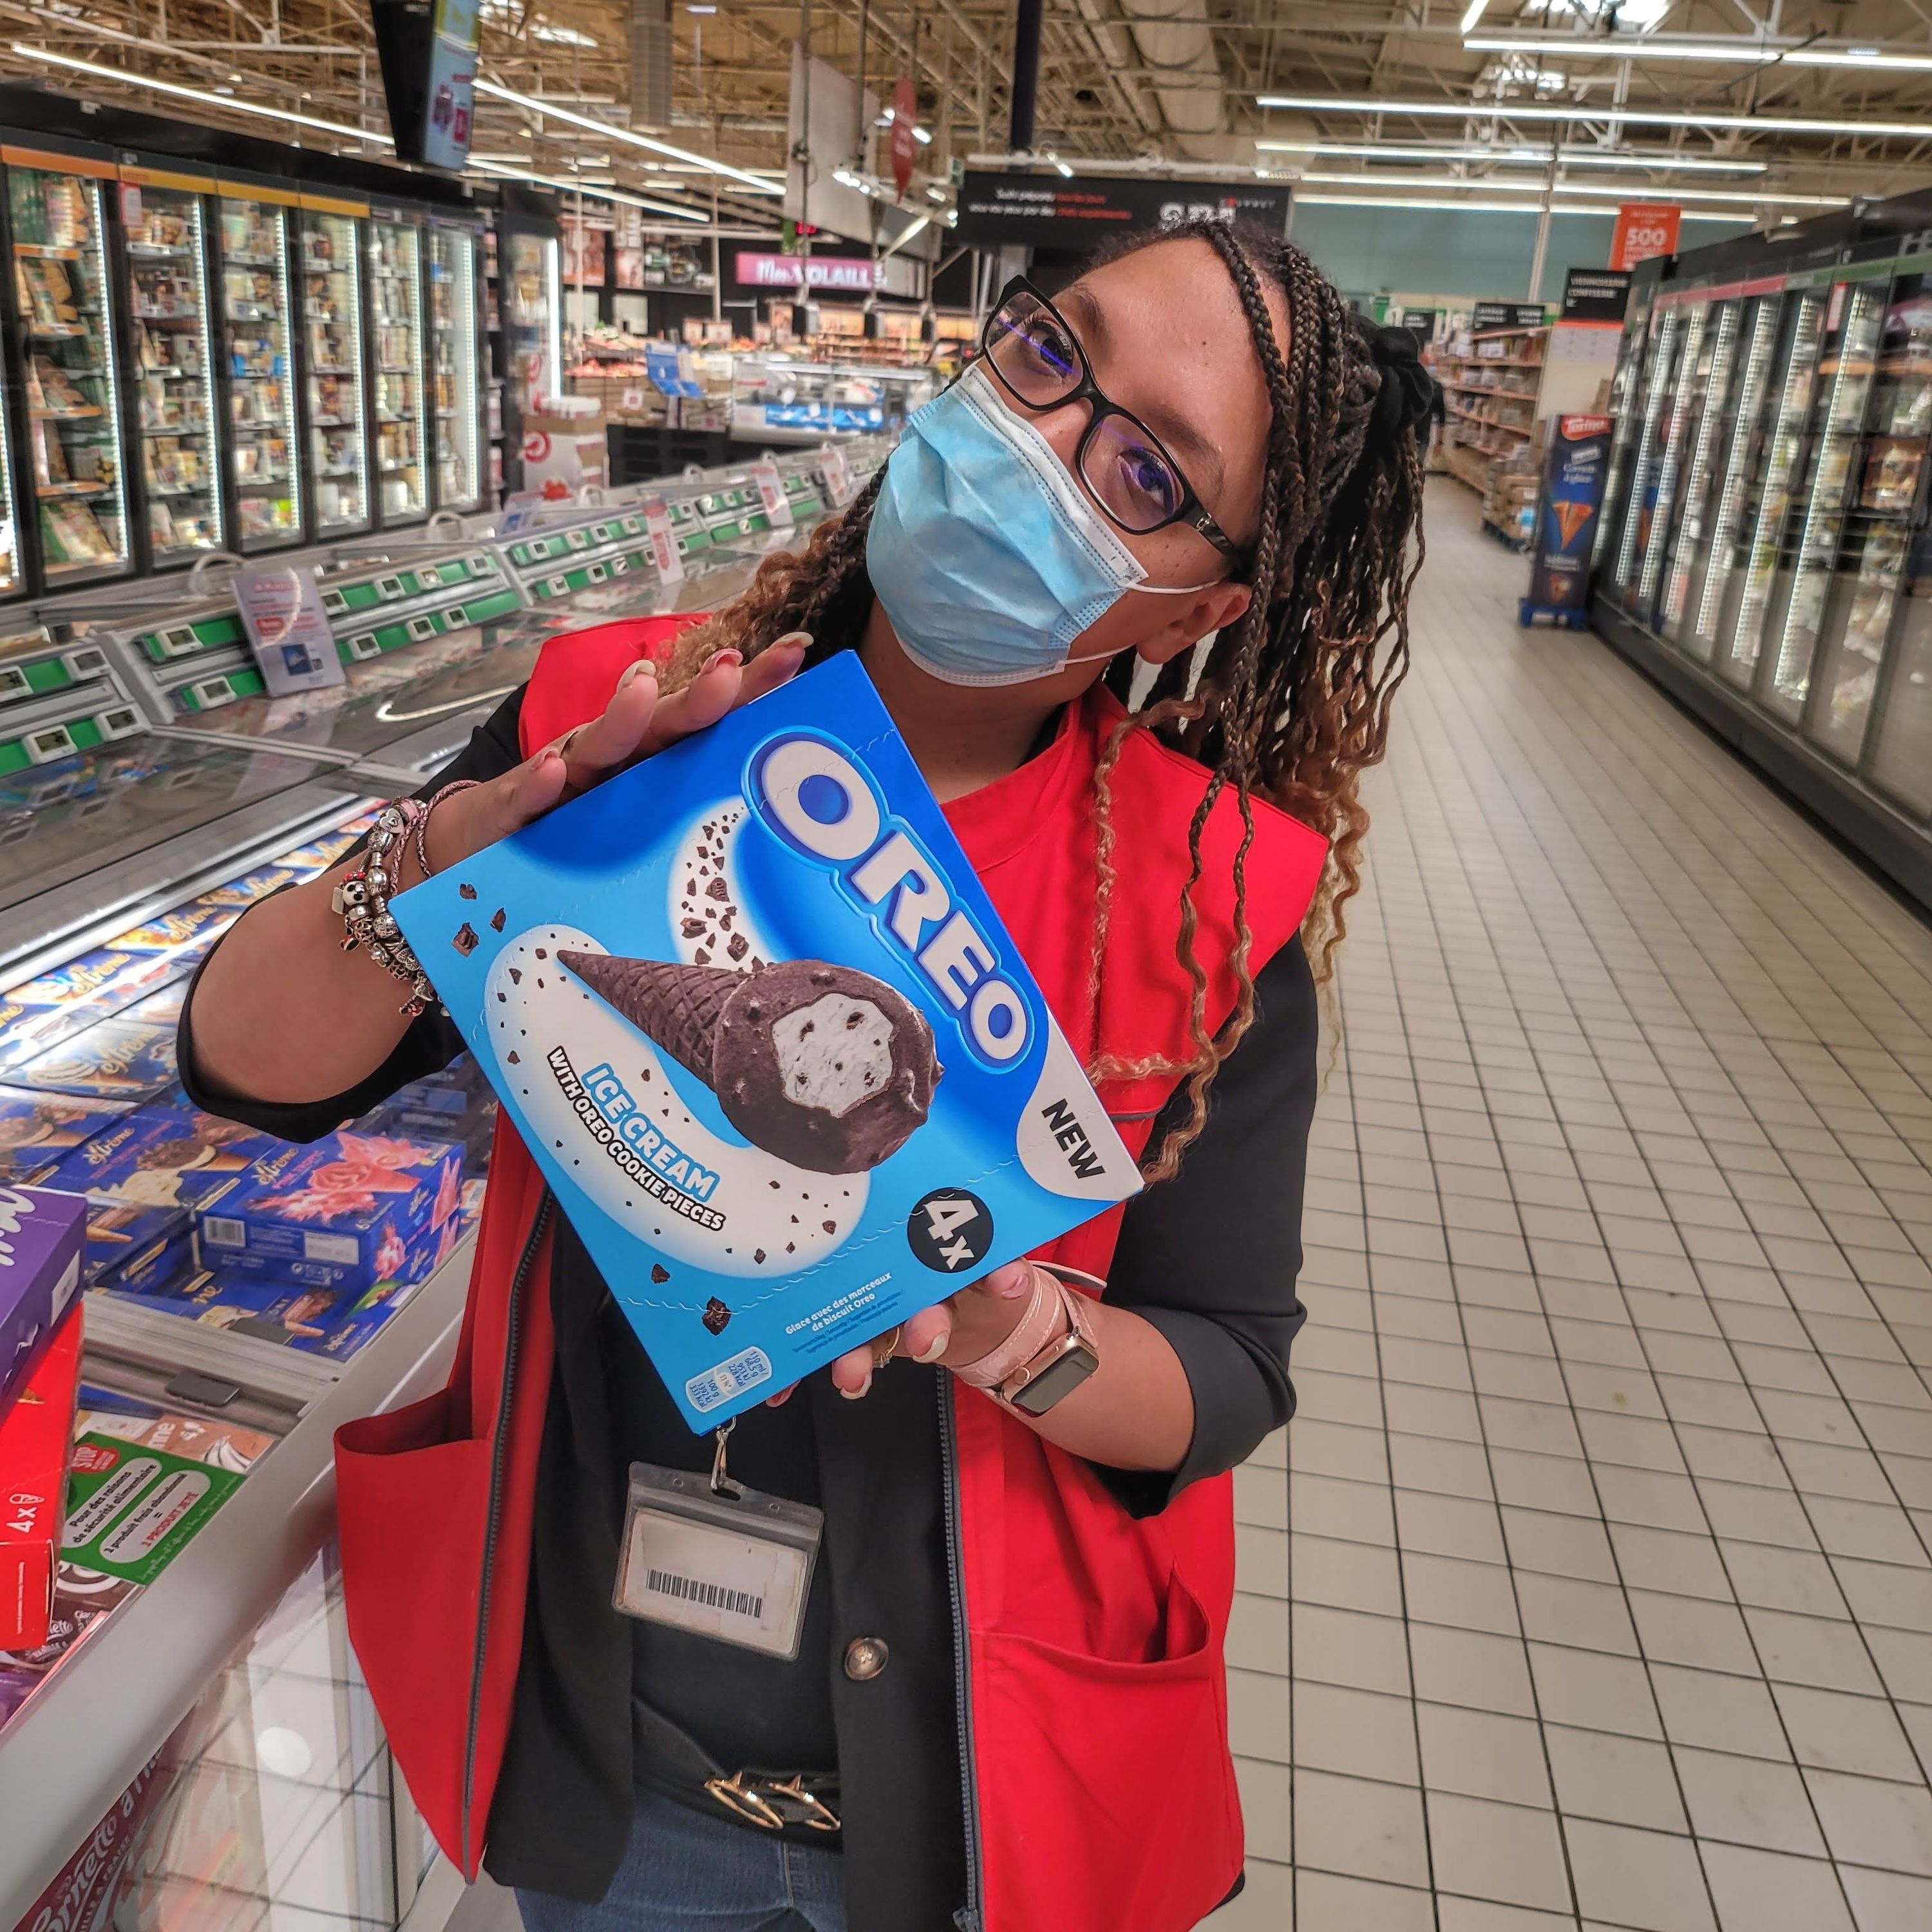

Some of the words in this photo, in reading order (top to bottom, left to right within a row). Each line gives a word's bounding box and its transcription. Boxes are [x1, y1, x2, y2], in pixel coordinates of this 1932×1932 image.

[759, 738, 1029, 1061] OREO
[547, 1046, 585, 1101] WITH
[573, 1096, 614, 1144] OREO
[607, 1139, 667, 1198] COOKIE
[660, 1186, 726, 1231] PIECES
[582, 1064, 636, 1122] ICE
[620, 1113, 719, 1202] CREAM
[1041, 1098, 1106, 1179] NEW
[923, 1199, 980, 1270] 4x
[785, 1316, 811, 1334] Glace
[810, 1305, 833, 1321] avec
[832, 1297, 849, 1308] des
[848, 1272, 892, 1300] morceaux
[811, 1321, 824, 1332] de
[823, 1304, 855, 1325] biscuit
[853, 1293, 876, 1308] Oreo
[736, 1362, 748, 1374] 953
[750, 1351, 761, 1363] 110
[697, 1382, 710, 1397] 1392
[707, 1379, 718, 1392] 100
[734, 1374, 746, 1387] kcal
[696, 1395, 707, 1408] kcal
[6, 1506, 37, 1533] 4x
[69, 1509, 92, 1528] Pour
[90, 1497, 106, 1510] des
[103, 1471, 132, 1498] raisons
[73, 1532, 86, 1544] de
[84, 1502, 117, 1533] sécurité
[113, 1463, 157, 1505] alimentaire
[111, 1520, 139, 1549] produit
[135, 1507, 153, 1526] frais
[146, 1508, 180, 1542] PRODUIT
